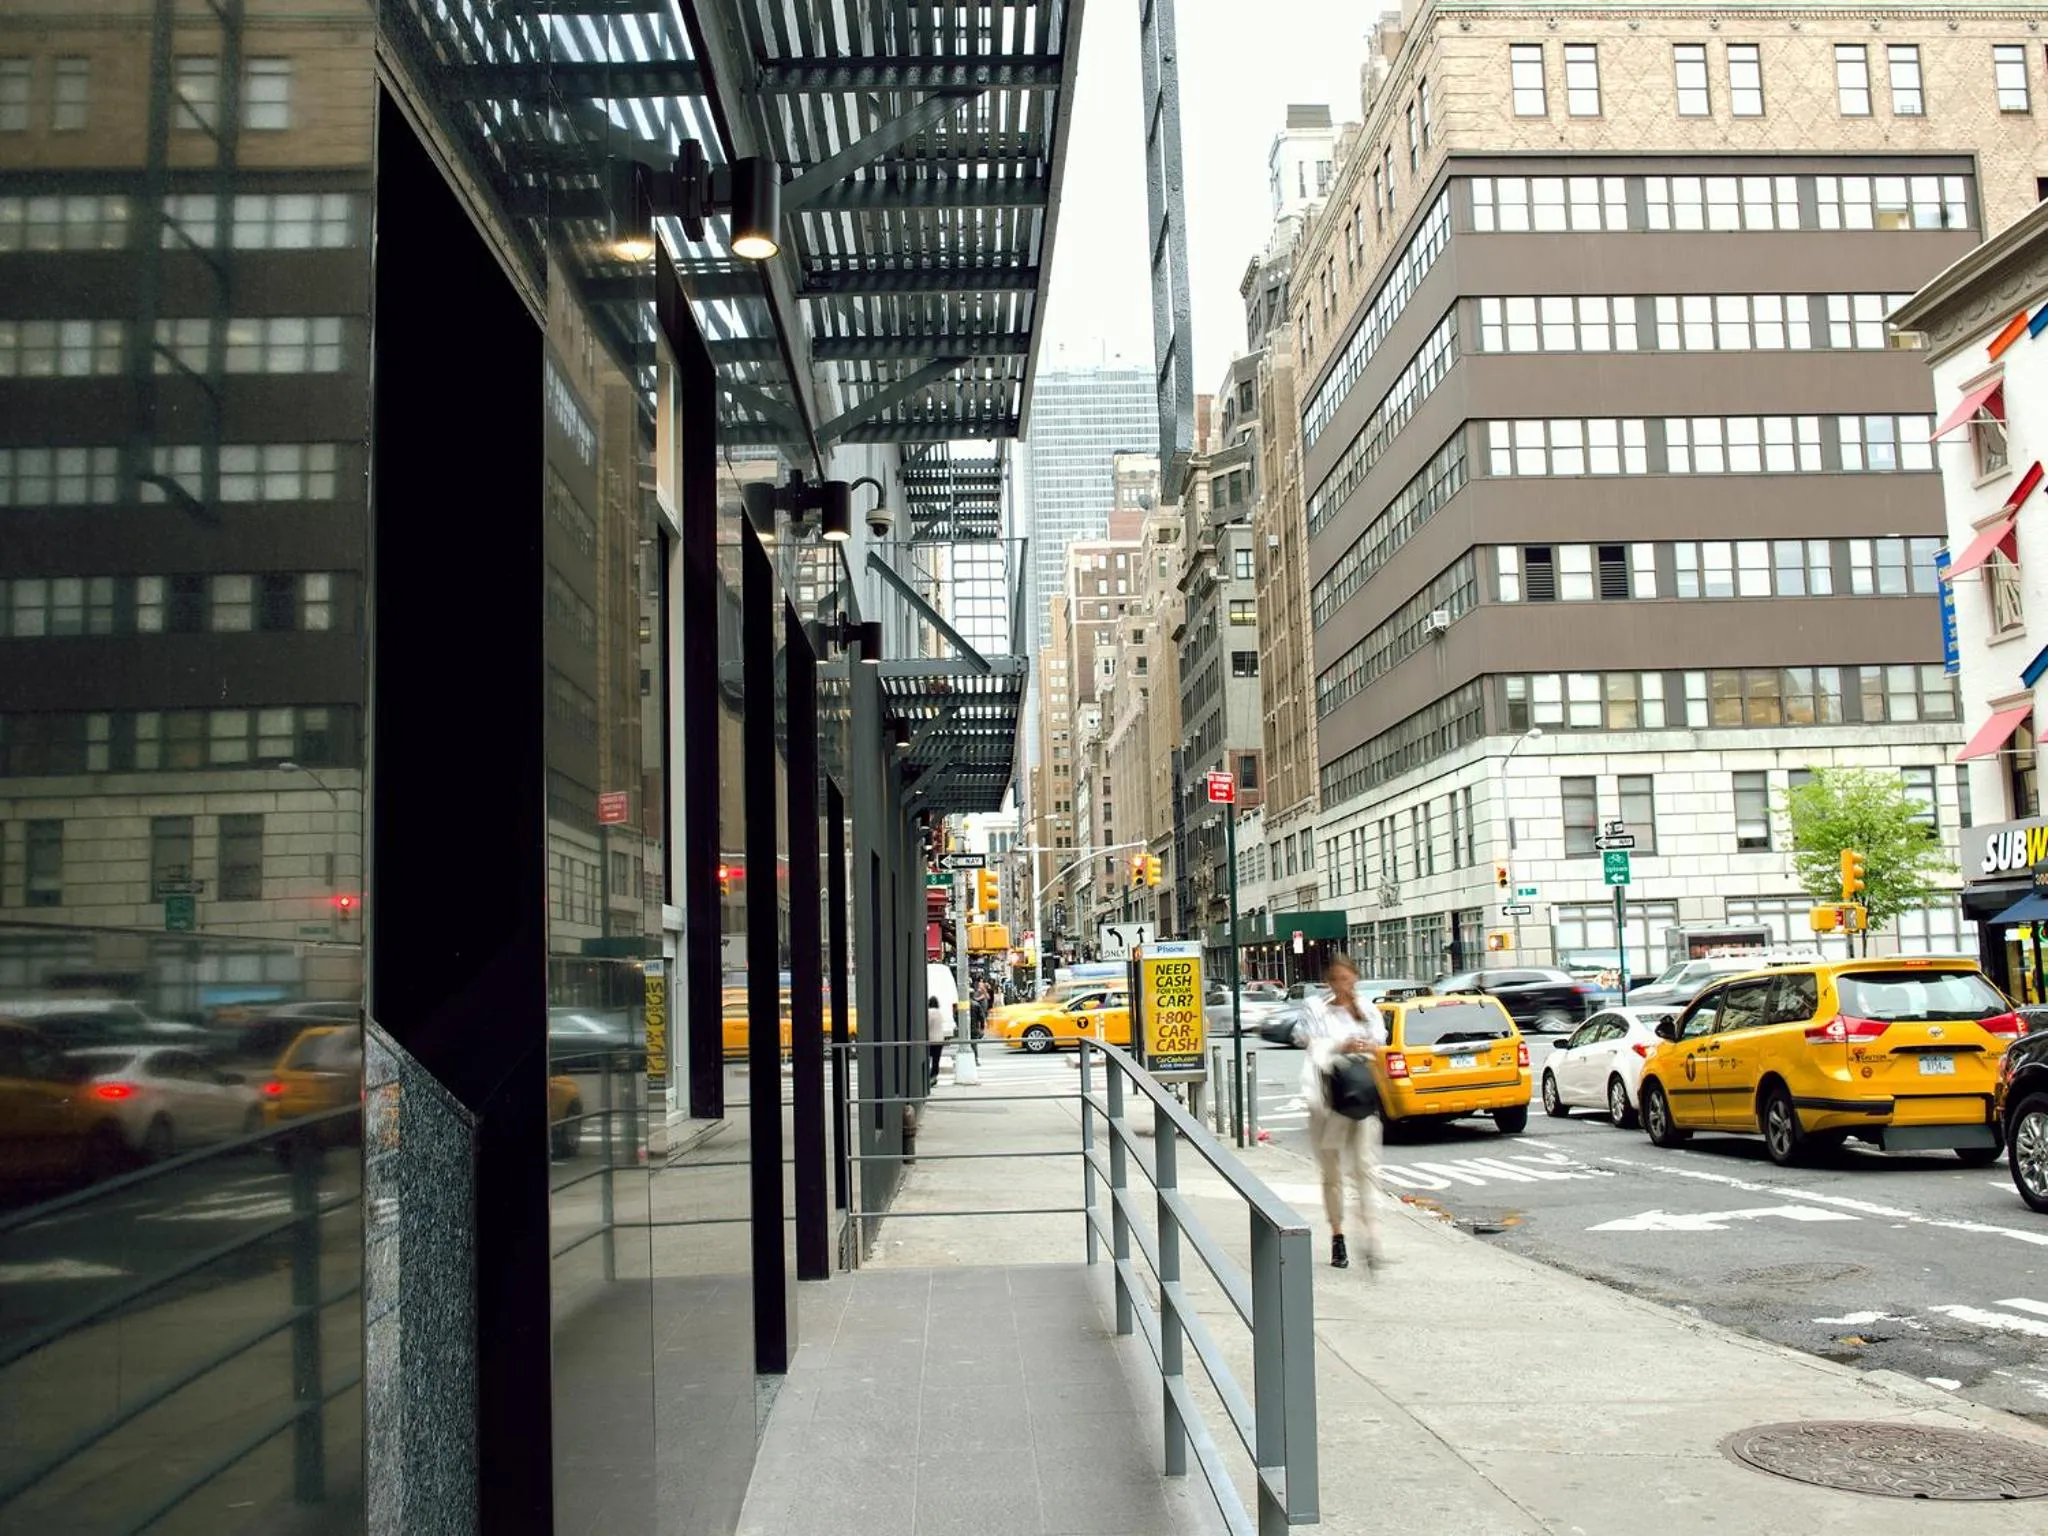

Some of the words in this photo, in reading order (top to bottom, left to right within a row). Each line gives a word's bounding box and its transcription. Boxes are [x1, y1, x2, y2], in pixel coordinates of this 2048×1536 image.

[965, 857, 980, 865] WAY
[1103, 950, 1126, 959] ONLY
[1155, 963, 1192, 976] NEED
[1155, 975, 1193, 988] CASH
[1157, 994, 1194, 1008] CAR?
[1156, 1011, 1199, 1024] 1-800-
[1158, 1024, 1196, 1038] CAR-
[1156, 1038, 1199, 1052] CASH
